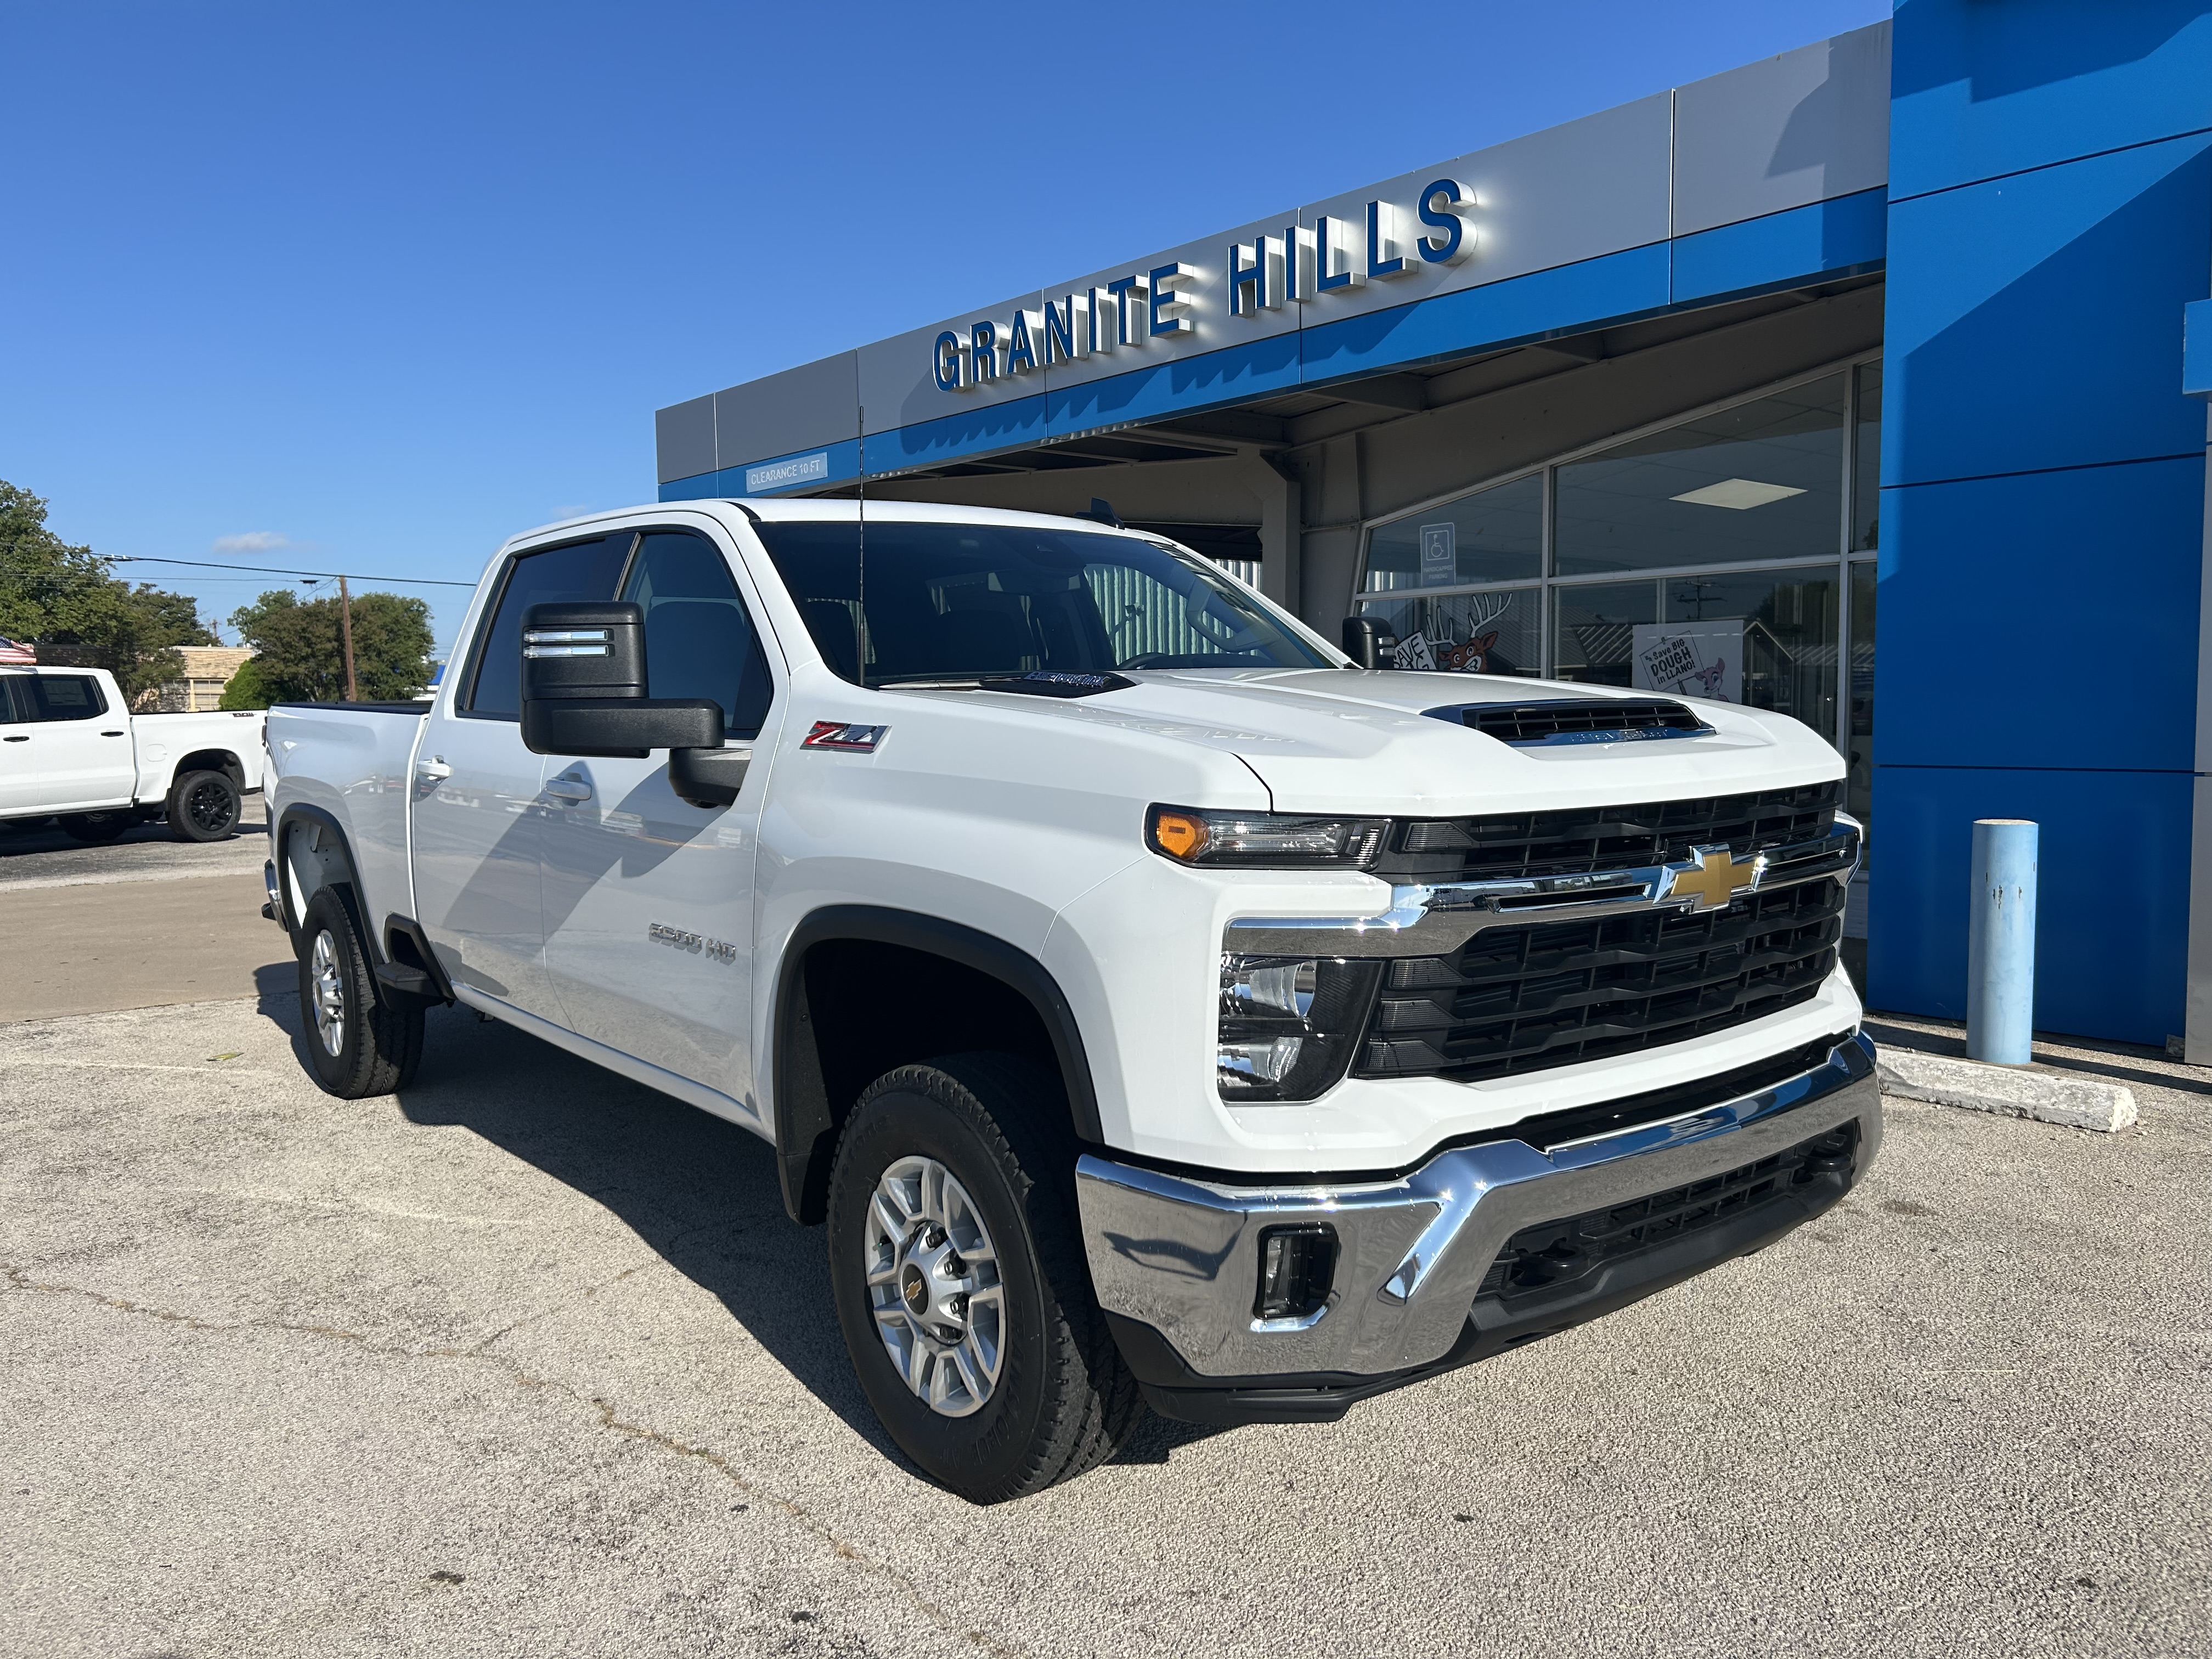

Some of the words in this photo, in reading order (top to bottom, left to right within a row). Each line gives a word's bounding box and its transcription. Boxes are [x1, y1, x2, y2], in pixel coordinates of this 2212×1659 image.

[933, 262, 1192, 392] GRANITE
[1228, 179, 1476, 318] HILLS
[752, 465, 797, 484] CLEARANCE
[799, 463, 808, 474] 10
[810, 460, 820, 472] FT
[1650, 646, 1692, 677] DOUGH
[1653, 647, 1671, 660] Save
[1671, 639, 1685, 650] BIG
[1666, 659, 1696, 680] LLANO!
